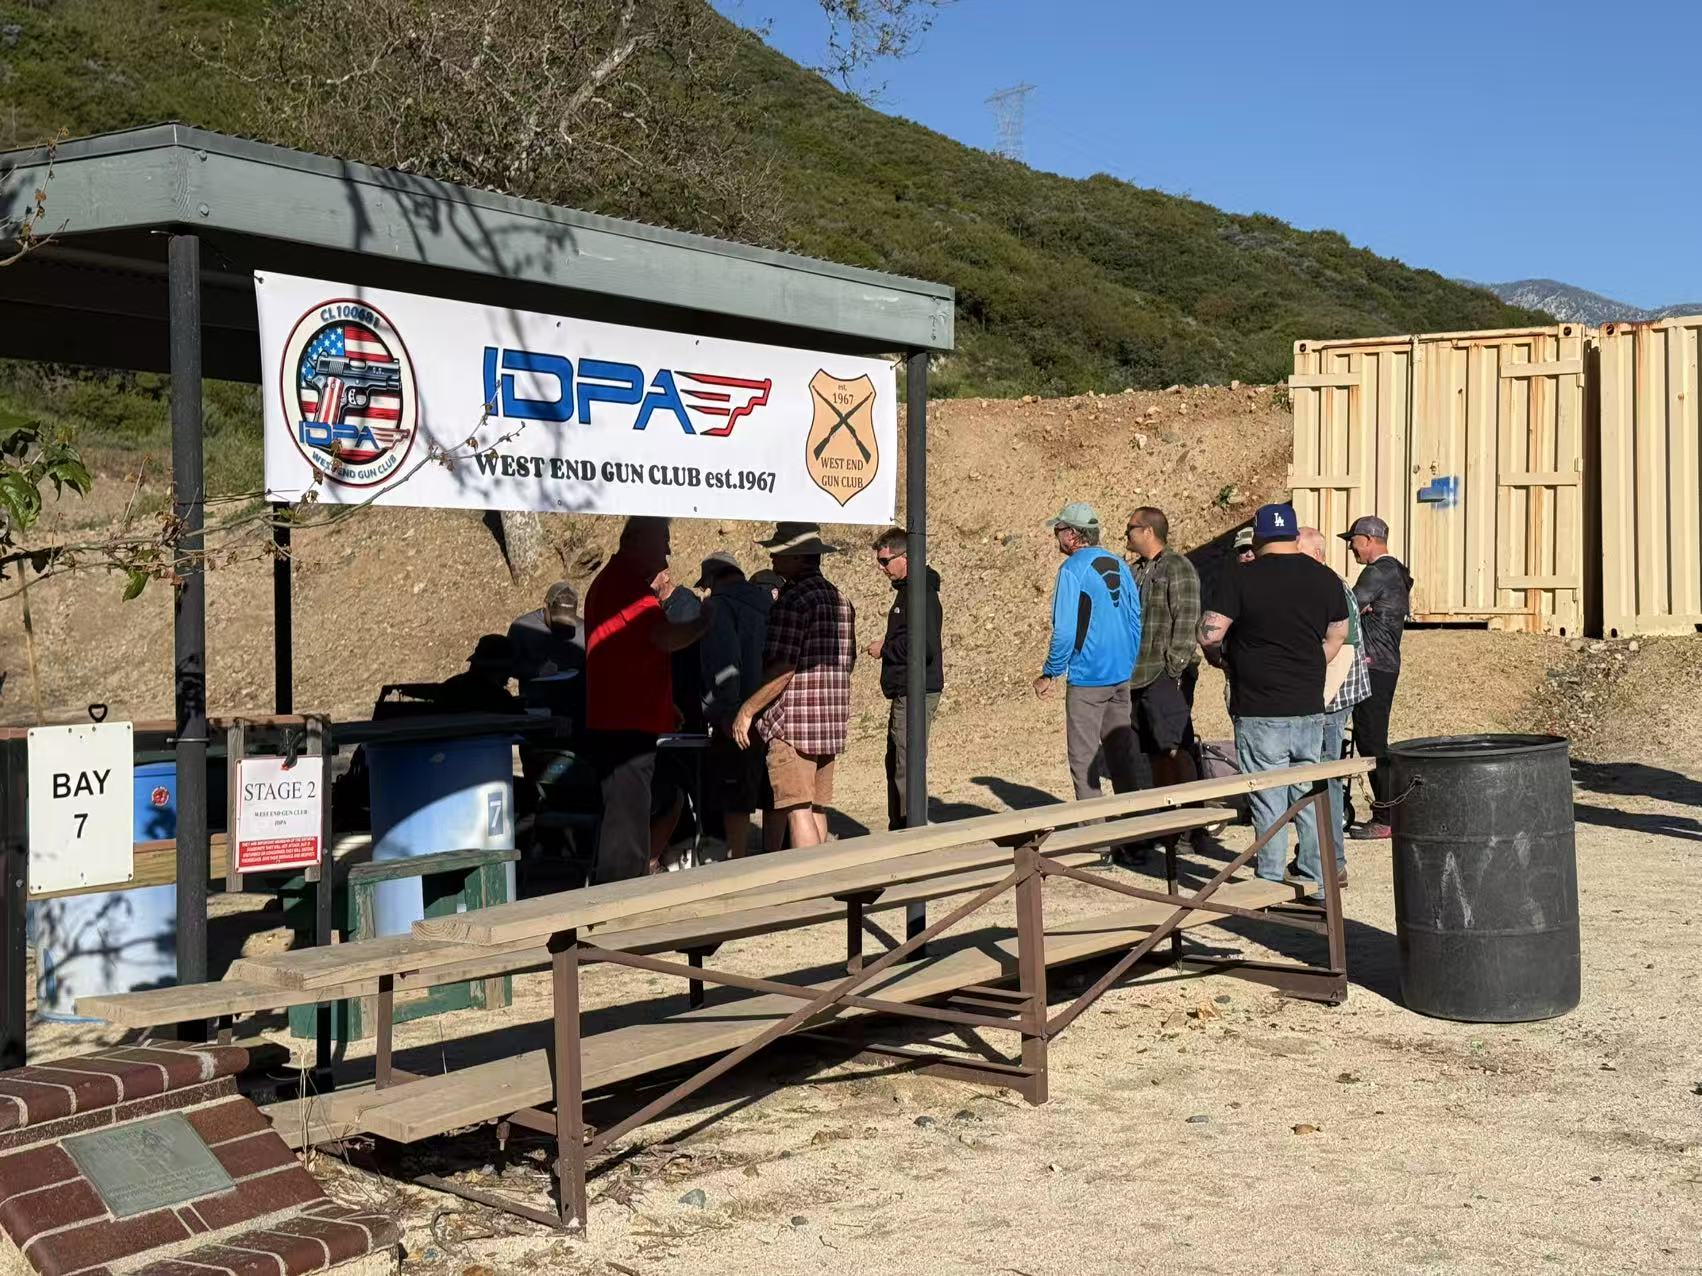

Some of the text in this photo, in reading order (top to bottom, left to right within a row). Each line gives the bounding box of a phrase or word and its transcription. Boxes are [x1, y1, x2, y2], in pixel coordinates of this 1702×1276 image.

[483, 346, 697, 435] IDPA
[832, 392, 854, 405] 1967
[298, 420, 380, 450] IDPA
[312, 450, 336, 472] WES
[357, 468, 377, 479] GUN
[377, 454, 397, 474] CLUB
[475, 453, 545, 477] WEST
[549, 458, 596, 481] END
[601, 461, 644, 483] GUN
[649, 464, 701, 487] CLUB
[820, 456, 864, 471] WEST END
[821, 474, 864, 488] GUN CLUB
[1274, 512, 1285, 527] LA
[53, 768, 112, 799] BAY
[244, 780, 317, 801] STAGE 2
[74, 812, 88, 839] 7
[490, 800, 502, 828] 7
